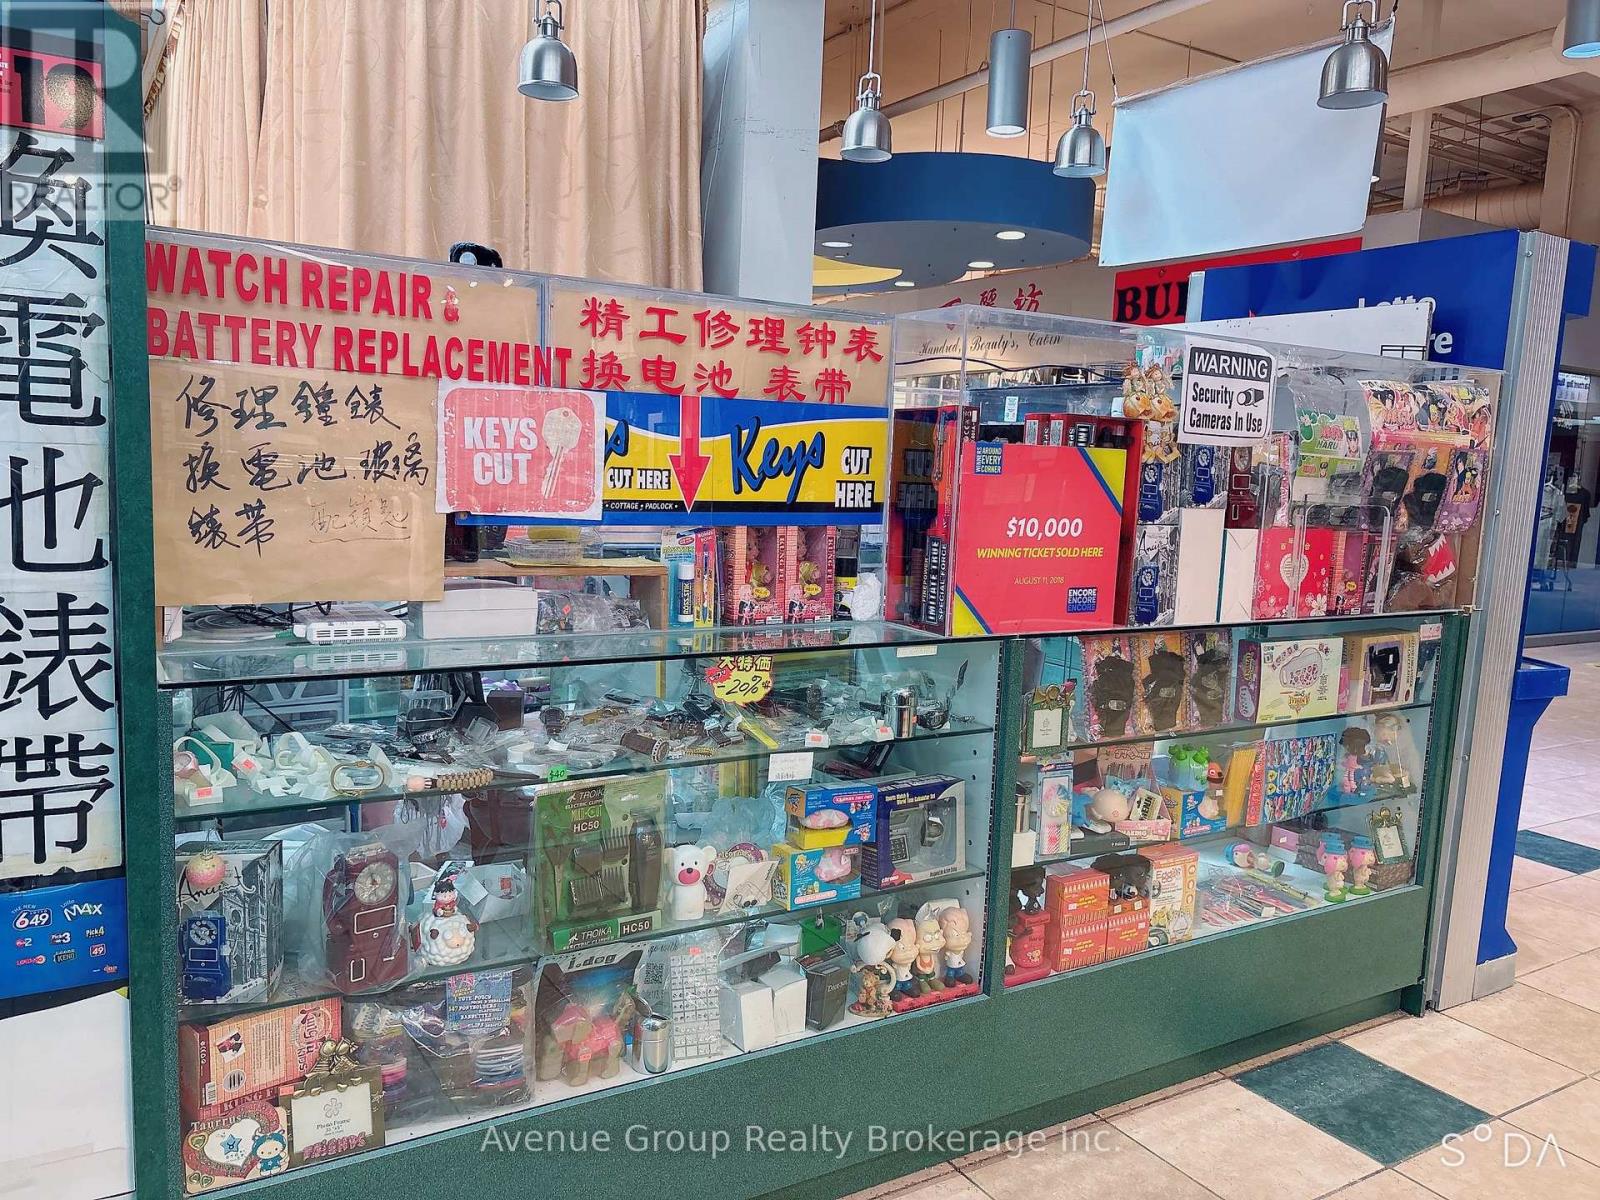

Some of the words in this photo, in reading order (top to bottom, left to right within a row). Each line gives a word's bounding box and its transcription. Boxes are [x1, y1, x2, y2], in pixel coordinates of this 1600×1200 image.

[146, 242, 287, 304] WATCH
[302, 262, 432, 319] REPAIR
[580, 297, 884, 362] 精工修理钟表
[148, 306, 323, 368] BATTERY
[334, 327, 572, 387] REPLACEMENT
[1194, 352, 1269, 379] WARNING
[579, 349, 739, 399] 换电池
[763, 364, 852, 404] 表带
[1192, 381, 1234, 409] Security
[1189, 408, 1232, 431] Cameras
[1234, 411, 1244, 431] In
[1245, 412, 1262, 433] Use
[464, 416, 539, 451] KEYS
[982, 446, 1002, 455] AROUND
[472, 452, 533, 486] CUT
[730, 416, 825, 504] Keys
[840, 447, 871, 475] CUT
[980, 465, 1001, 473] CORNER
[981, 456, 1001, 465] EVERY
[607, 468, 633, 490] CUT
[636, 469, 671, 490] HERE
[835, 480, 876, 509] HERE
[610, 502, 639, 511] COTTAGE
[645, 502, 674, 510] PADLOCK
[1006, 517, 1083, 541] $10,000
[930, 540, 940, 572] TRUE
[976, 548, 1022, 559] WINNING
[1023, 548, 1055, 558] TICKET
[1056, 548, 1080, 558] SOLD
[1081, 547, 1104, 558] HERE
[1014, 576, 1040, 585] AUGUST
[1049, 576, 1065, 584] 2018
[928, 574, 938, 621] IMITATE
[1067, 596, 1096, 605] ENCORE
[1068, 588, 1097, 597] ENCORE
[1067, 604, 1096, 612] ENCORE
[549, 769, 566, 779] $40
[573, 820, 600, 833] HC50
[15, 911, 49, 928] 649
[63, 902, 103, 922] MAX
[98, 926, 104, 936] 4
[581, 924, 612, 939] TROIKA
[622, 920, 650, 935] HC50
[62, 932, 71, 944] 3
[92, 946, 104, 956] 49
